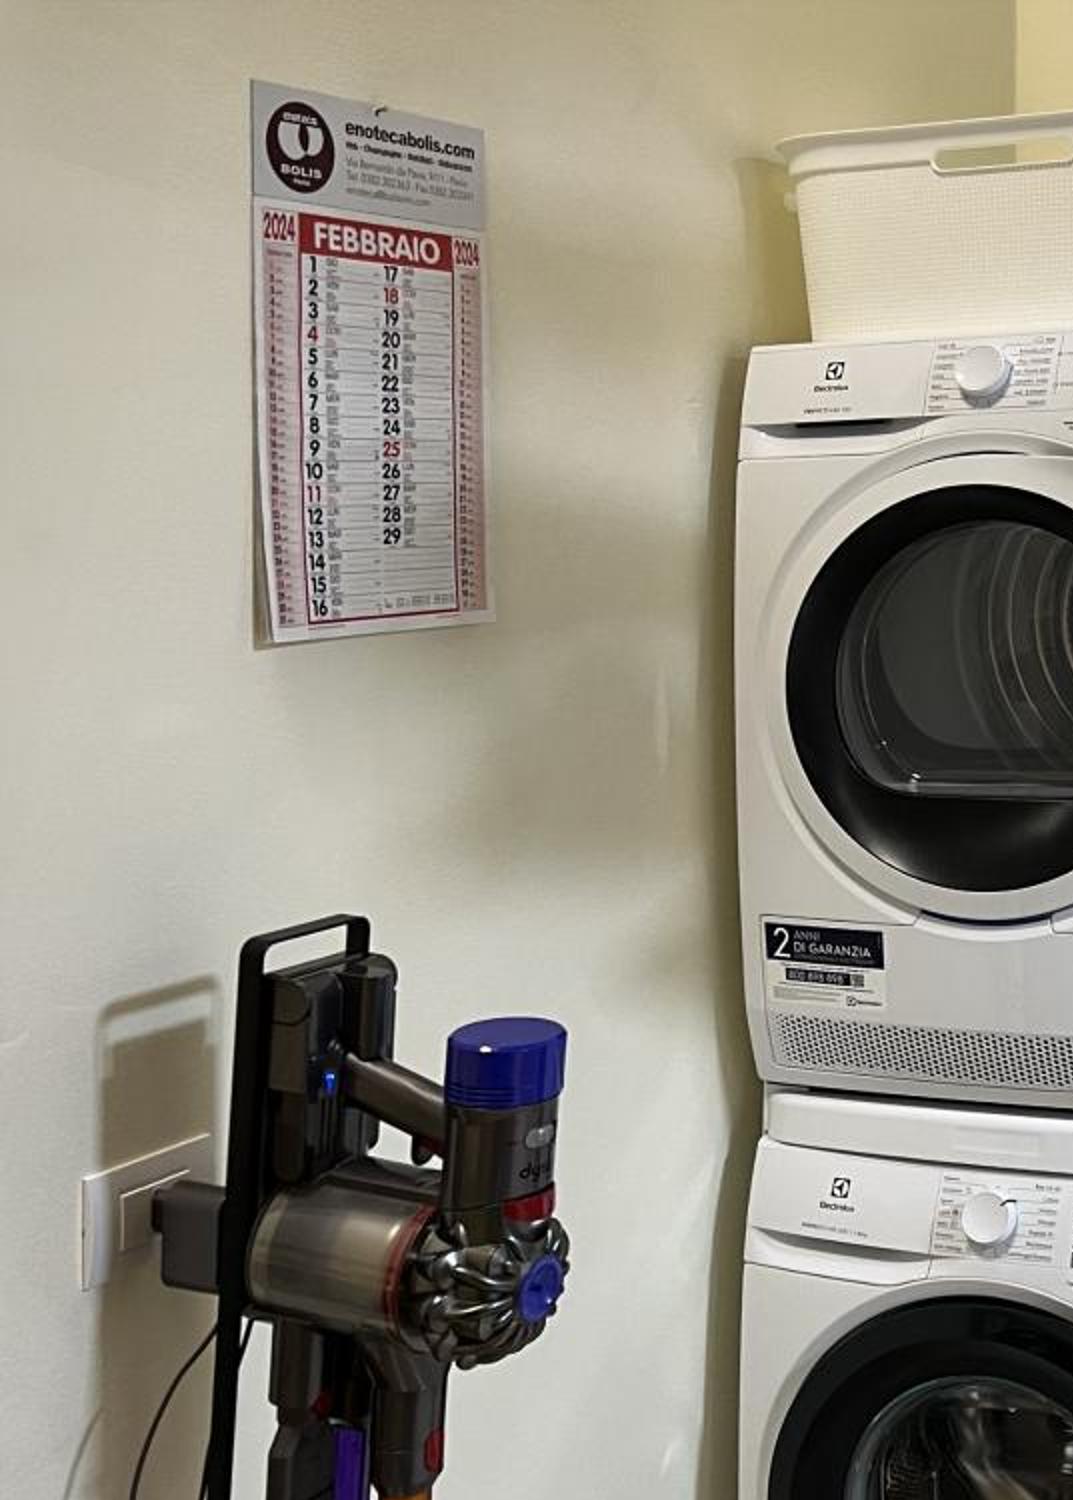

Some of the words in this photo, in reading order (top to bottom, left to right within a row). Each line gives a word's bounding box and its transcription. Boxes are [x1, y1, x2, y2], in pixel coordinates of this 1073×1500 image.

[345, 122, 475, 160] enotecabolis.com
[281, 163, 323, 179] BOLIS
[263, 212, 296, 241] 2024
[313, 221, 441, 265] FEBBRAIO
[453, 239, 480, 266] 2024
[309, 256, 318, 272] 1
[384, 265, 398, 282] 17
[308, 280, 318, 296] 2
[384, 287, 399, 305] 18
[308, 302, 318, 319] 3
[384, 309, 399, 326] 19
[307, 325, 319, 344] 4
[382, 331, 401, 349] 20
[308, 348, 318, 364] 5
[382, 353, 398, 370] 21
[308, 371, 318, 388] 6
[382, 375, 399, 392] 22
[309, 394, 319, 411] 7
[382, 397, 400, 415] 23
[309, 417, 320, 434] 8
[383, 419, 400, 437] 24
[309, 439, 320, 456] 9
[383, 441, 400, 458] 25
[306, 463, 323, 480] 10
[382, 463, 400, 480] 26
[307, 485, 321, 502] 11
[383, 485, 400, 502] 27
[308, 508, 323, 526] 12
[383, 507, 401, 524] 28
[308, 531, 324, 548] 13
[383, 528, 401, 546] 29
[309, 553, 325, 571] 14
[311, 576, 327, 594] 15
[313, 599, 329, 617] 16
[773, 927, 791, 958] 2
[794, 930, 821, 941] ANNI
[794, 942, 806, 952] DI
[808, 943, 872, 958] GARANZIA
